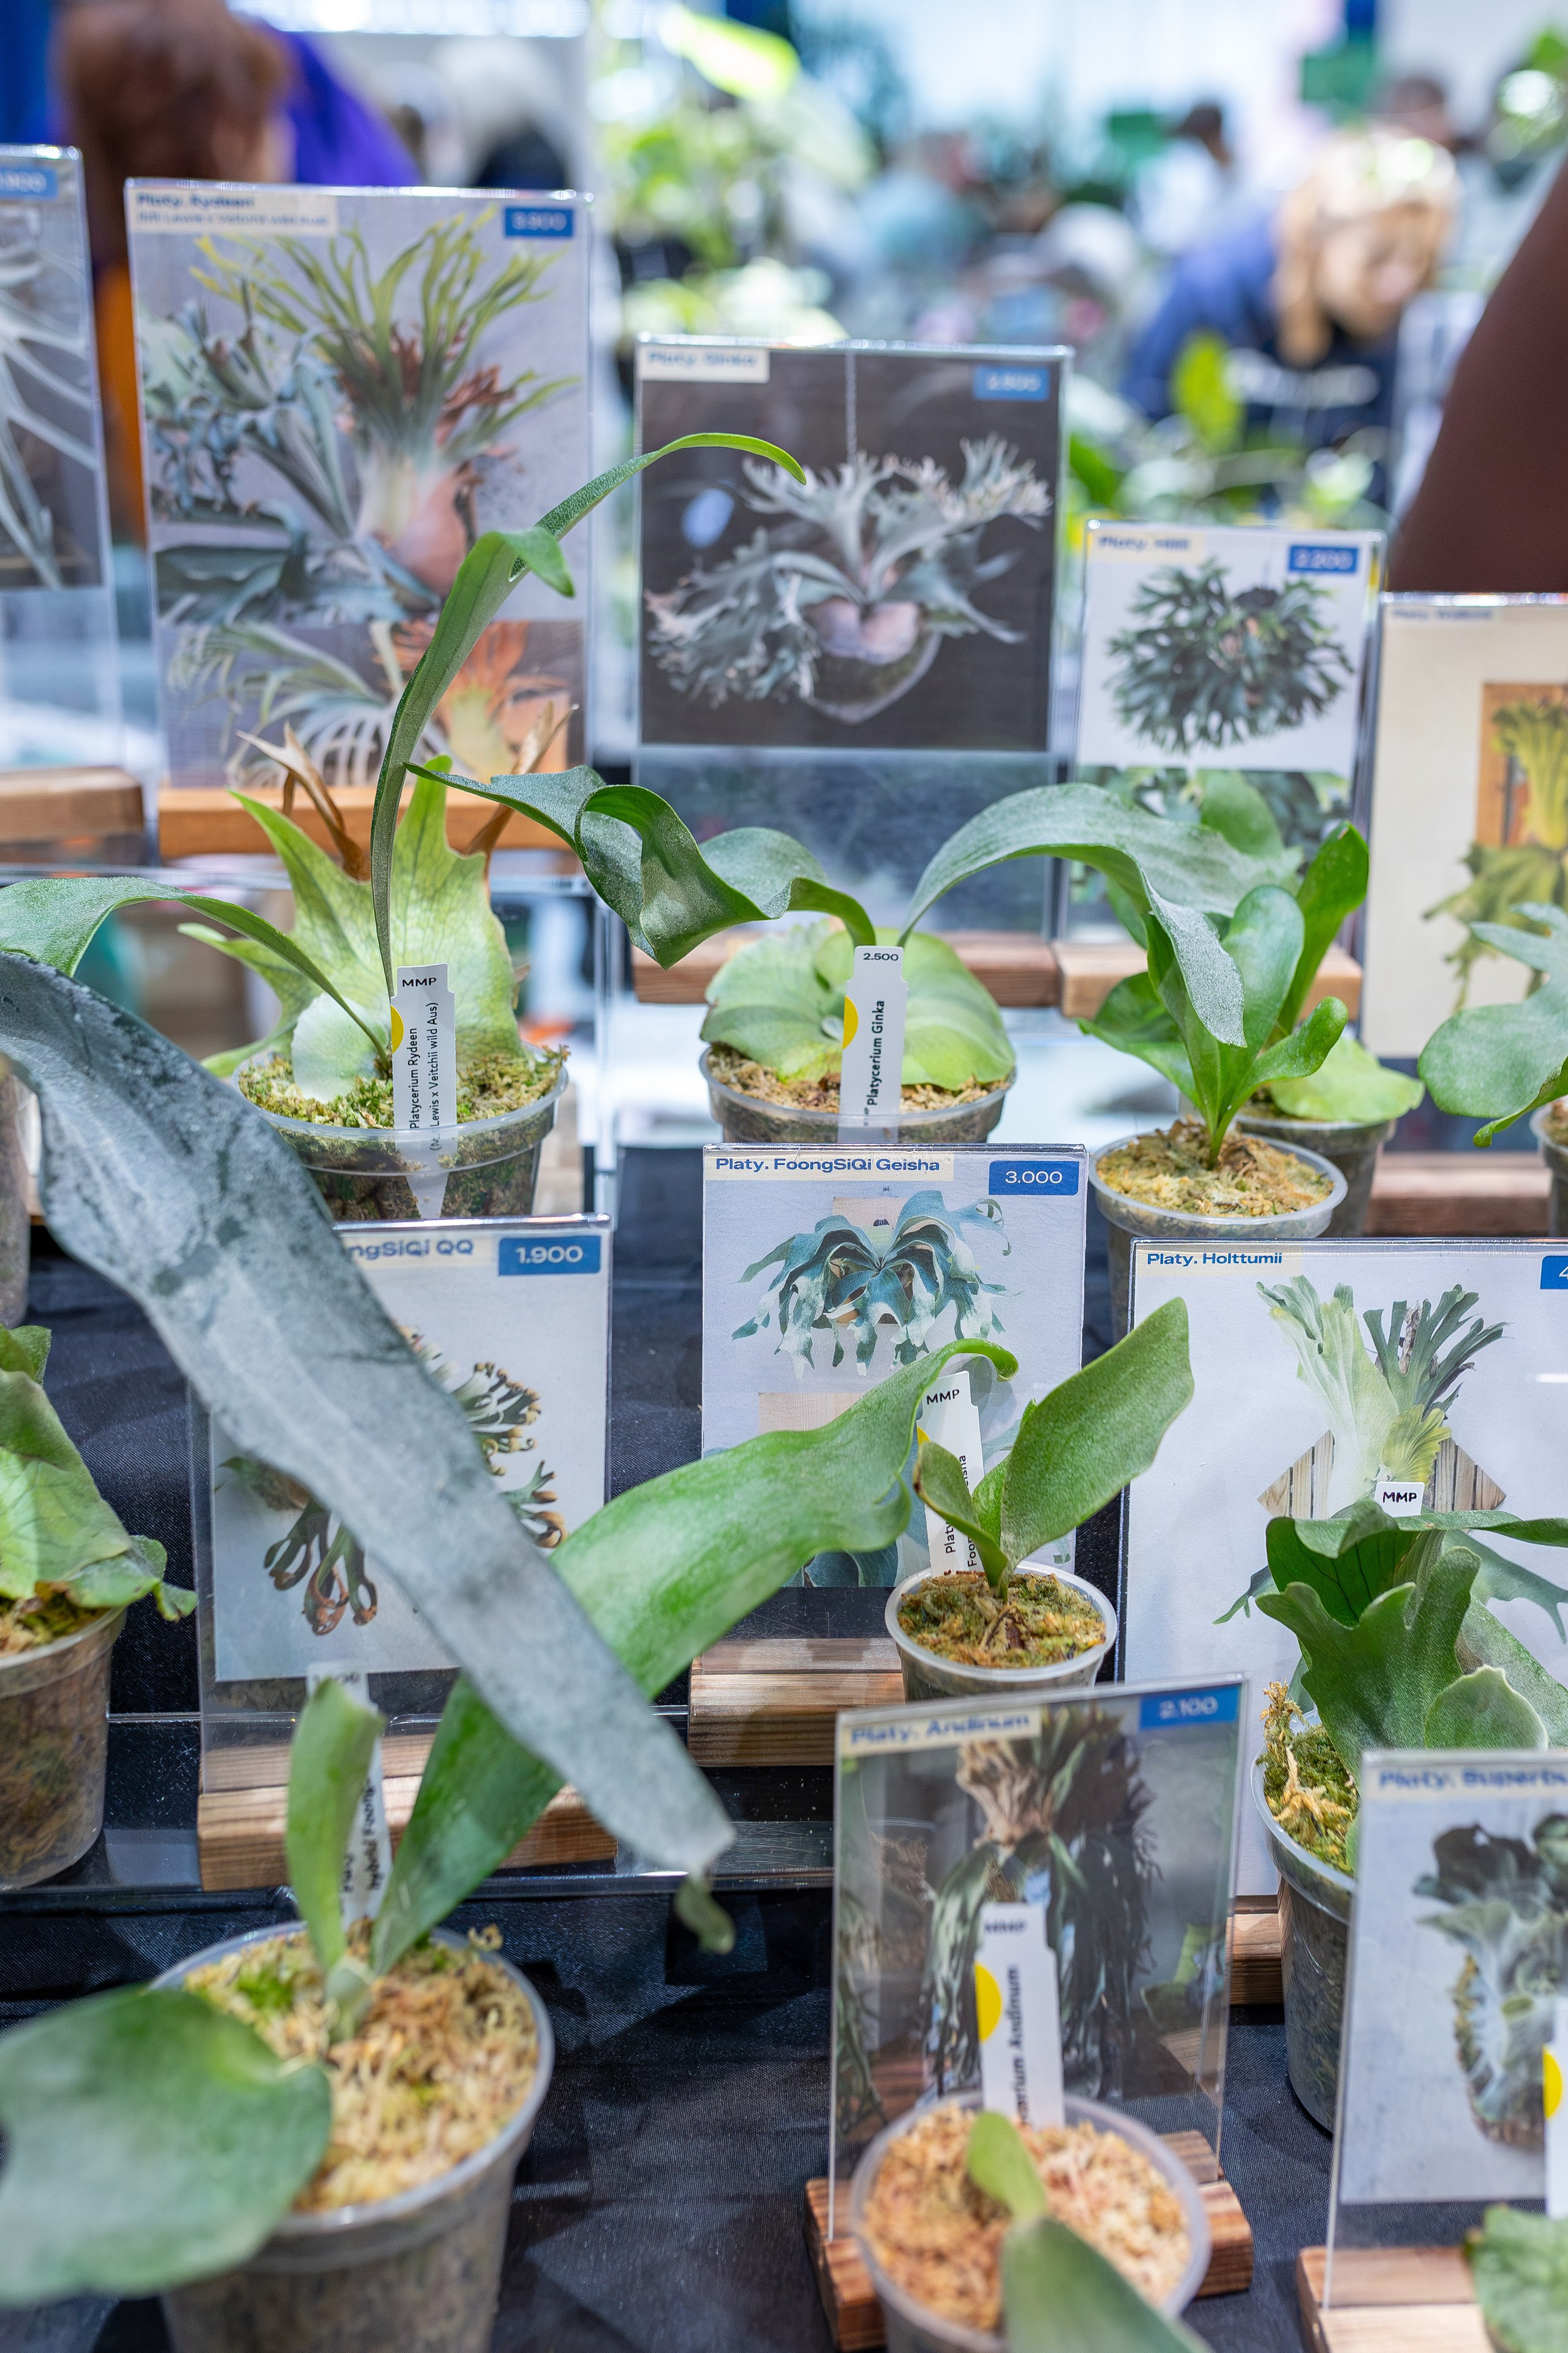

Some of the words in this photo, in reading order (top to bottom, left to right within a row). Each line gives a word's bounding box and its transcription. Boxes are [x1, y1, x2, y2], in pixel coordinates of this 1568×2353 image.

[863, 953, 899, 961] 2.500
[402, 977, 437, 988] MMP
[426, 1002, 439, 1025] Aus)
[872, 1000, 885, 1034] Ginka
[407, 1027, 421, 1067] Rydeen
[427, 1029, 438, 1049] wild
[428, 1052, 439, 1090] Veitchii
[867, 1038, 883, 1106] Platycerium
[408, 1069, 422, 1129] Platycerium
[430, 1100, 440, 1127] Lewis
[716, 1158, 769, 1173] Platy.
[774, 1158, 872, 1173] FoongSiQi
[876, 1158, 940, 1171] Geisha
[1005, 1171, 1063, 1184] 3.000
[347, 1239, 430, 1260] ngSiQi
[437, 1238, 474, 1256] QQ
[516, 1244, 584, 1264] 1.900
[1147, 1253, 1198, 1267] Platy.
[1202, 1252, 1283, 1264] Holttumii
[926, 1389, 960, 1405] MMP
[1382, 1491, 1417, 1503] MMP
